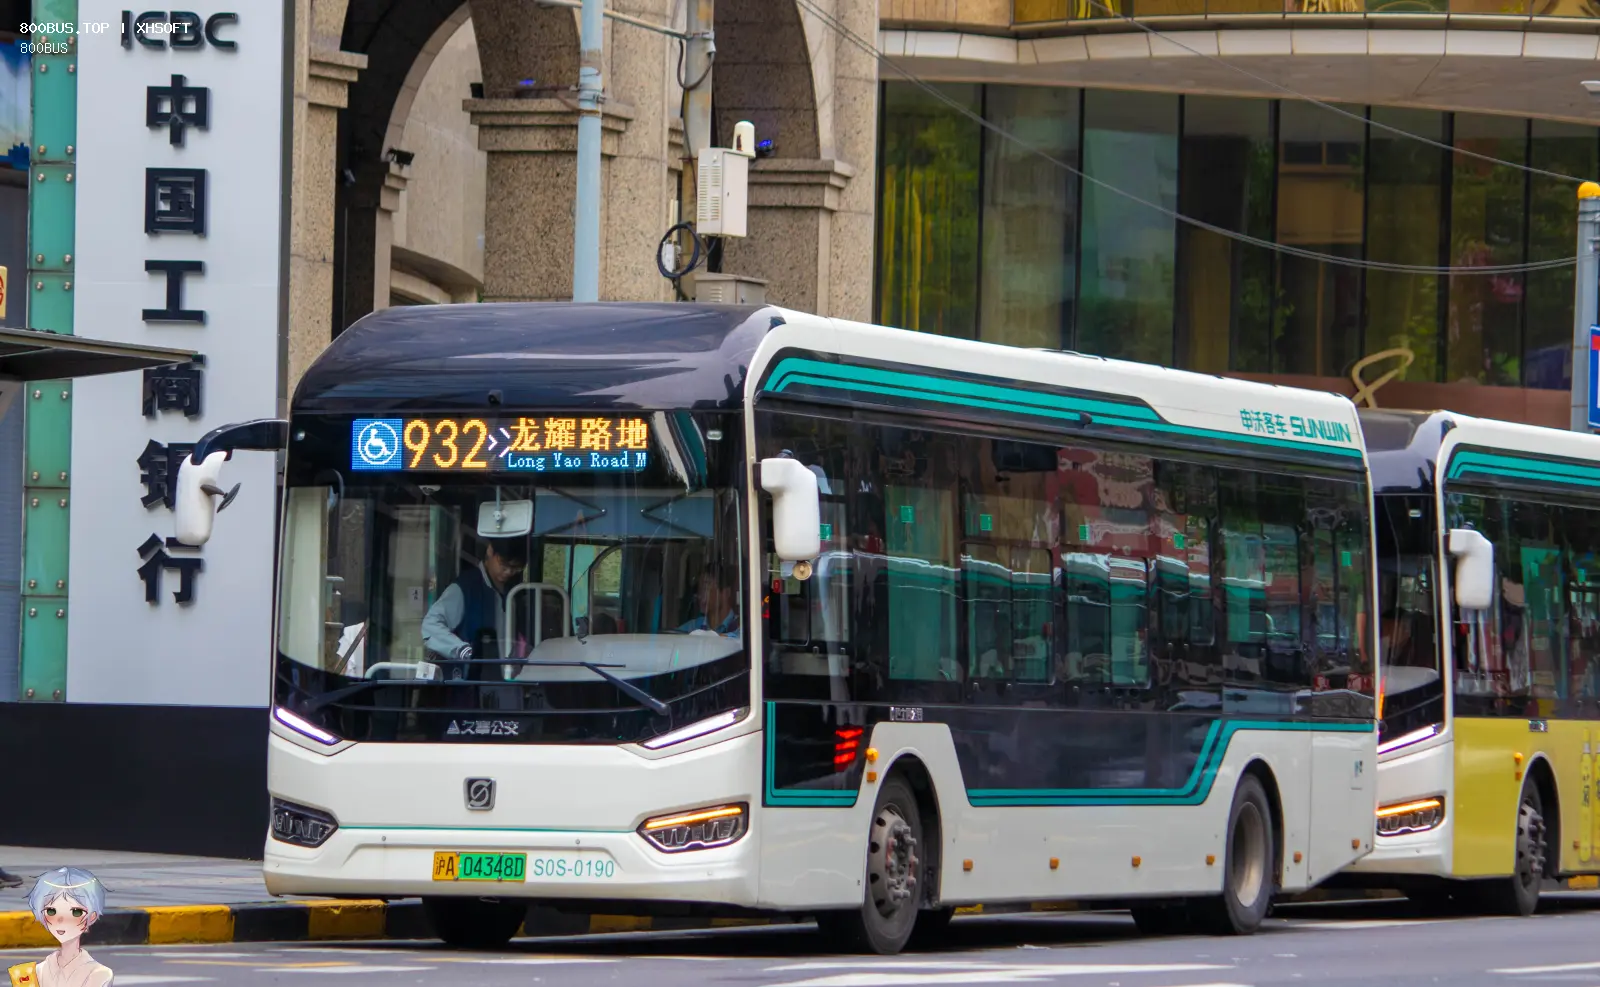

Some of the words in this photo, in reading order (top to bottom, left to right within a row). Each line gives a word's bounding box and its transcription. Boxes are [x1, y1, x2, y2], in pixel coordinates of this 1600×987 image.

[121, 10, 239, 51] ICBC
[403, 419, 487, 468] 932
[510, 417, 647, 451] 龙耀路地
[1239, 408, 1288, 436] 申沃客车
[1289, 415, 1352, 443] SUNWIN
[508, 452, 545, 470] Long
[554, 453, 581, 468] Yao
[590, 452, 629, 468] Road
[435, 856, 455, 876] 沪A
[463, 856, 524, 877] 04348D
